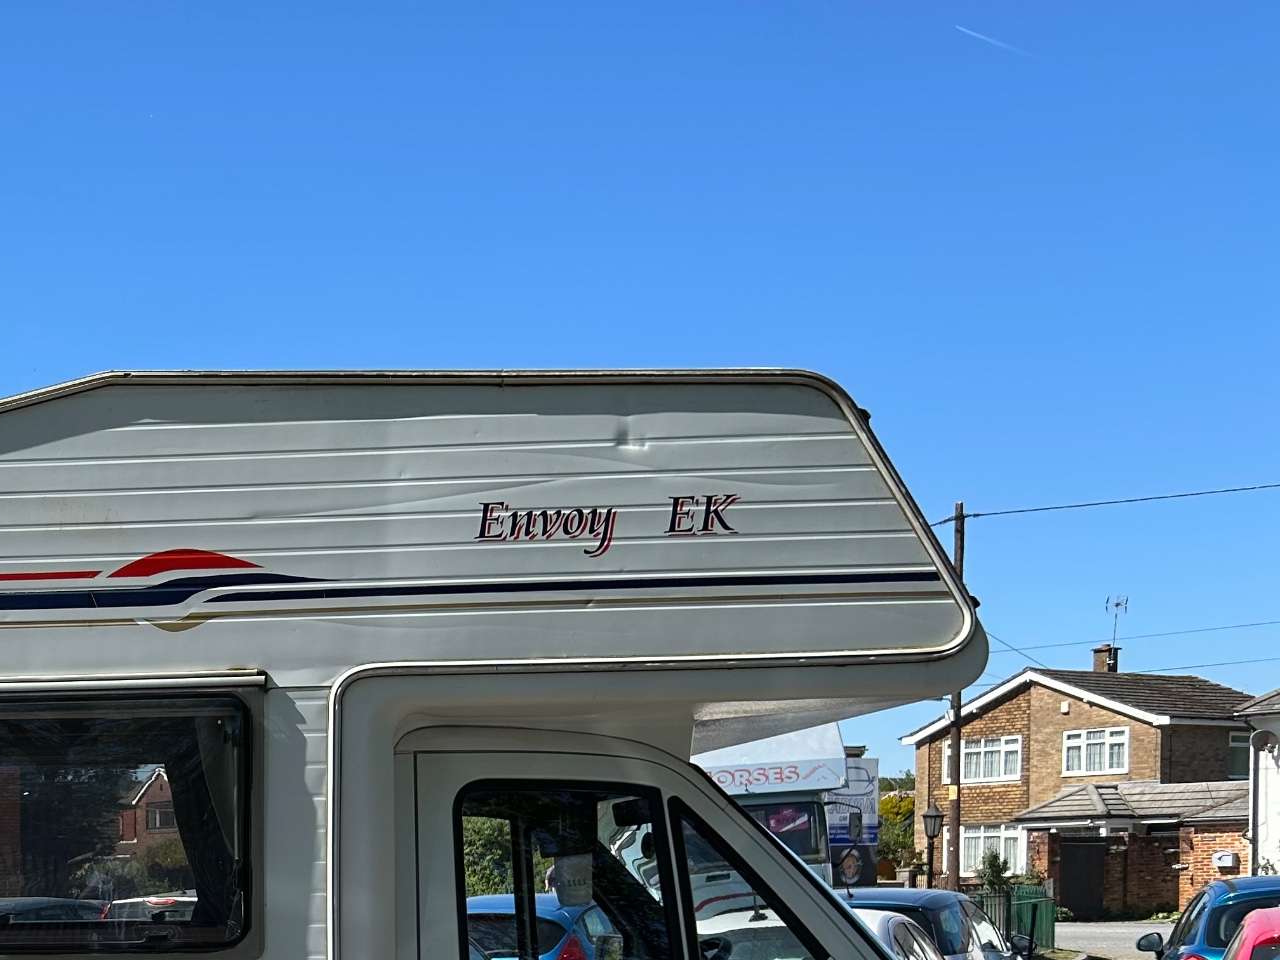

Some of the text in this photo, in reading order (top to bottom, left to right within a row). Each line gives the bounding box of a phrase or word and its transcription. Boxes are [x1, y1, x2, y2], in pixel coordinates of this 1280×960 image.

[474, 494, 741, 558] Envoy EK
[707, 765, 800, 787] ORSES
